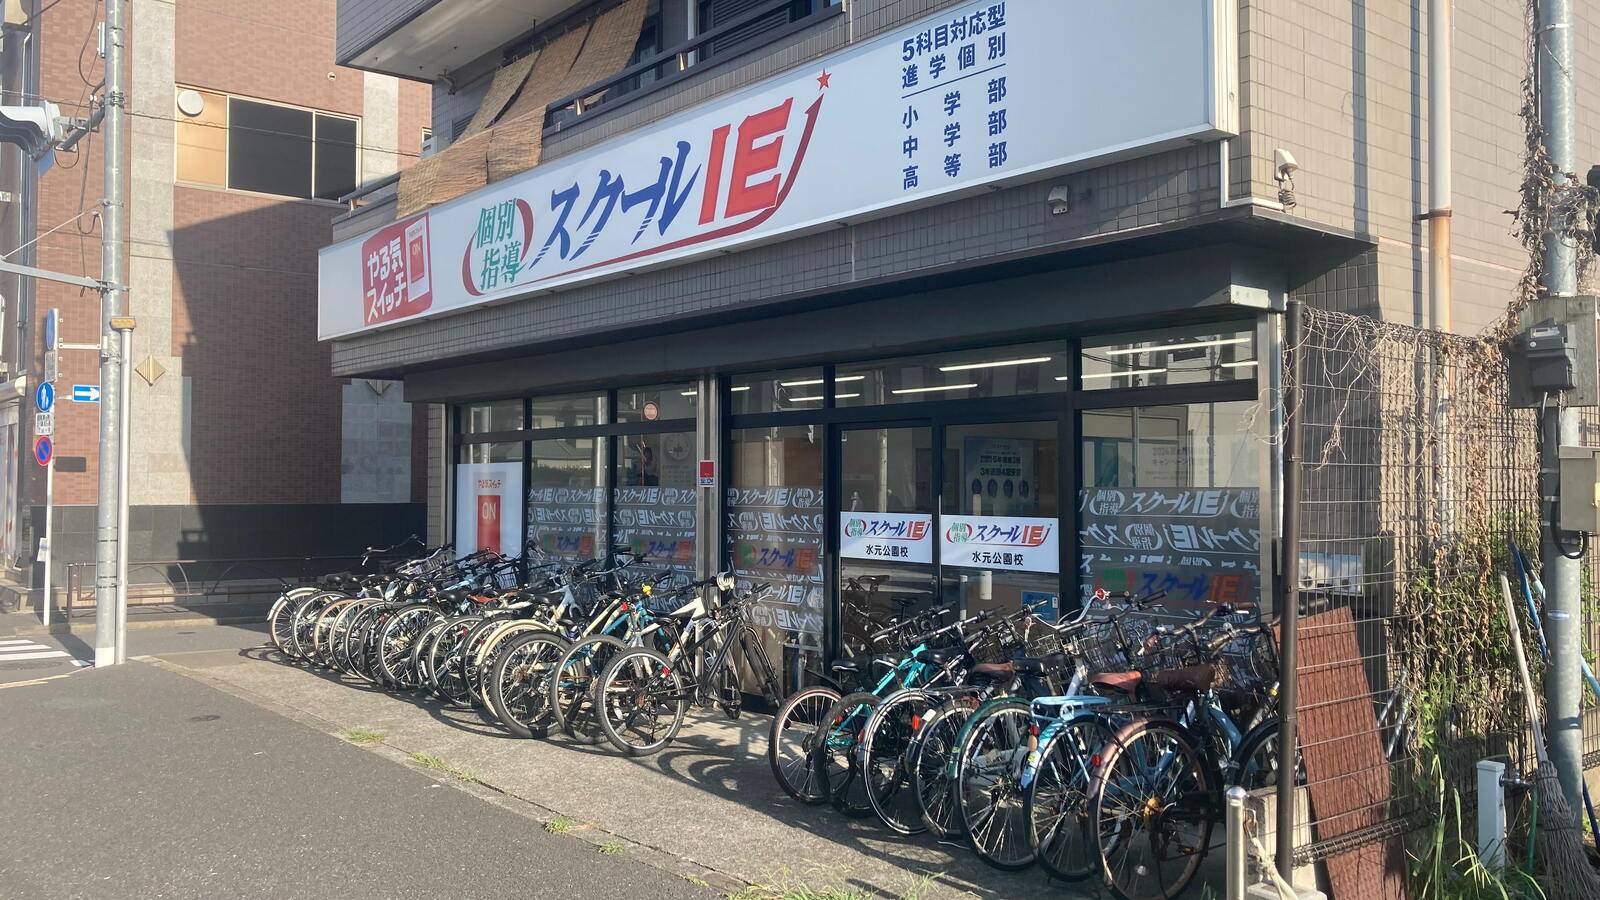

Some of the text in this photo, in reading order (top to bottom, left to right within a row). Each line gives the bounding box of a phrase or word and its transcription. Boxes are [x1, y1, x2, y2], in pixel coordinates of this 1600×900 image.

[902, 2, 1006, 62] 5科目対応型
[475, 198, 517, 249] 個別
[367, 236, 404, 287] やる気
[480, 241, 527, 290] 指導
[367, 271, 407, 323] スイッチ
[482, 502, 496, 520] ON
[866, 544, 908, 557] 水元公園校
[972, 551, 1024, 566] 水元公園校
